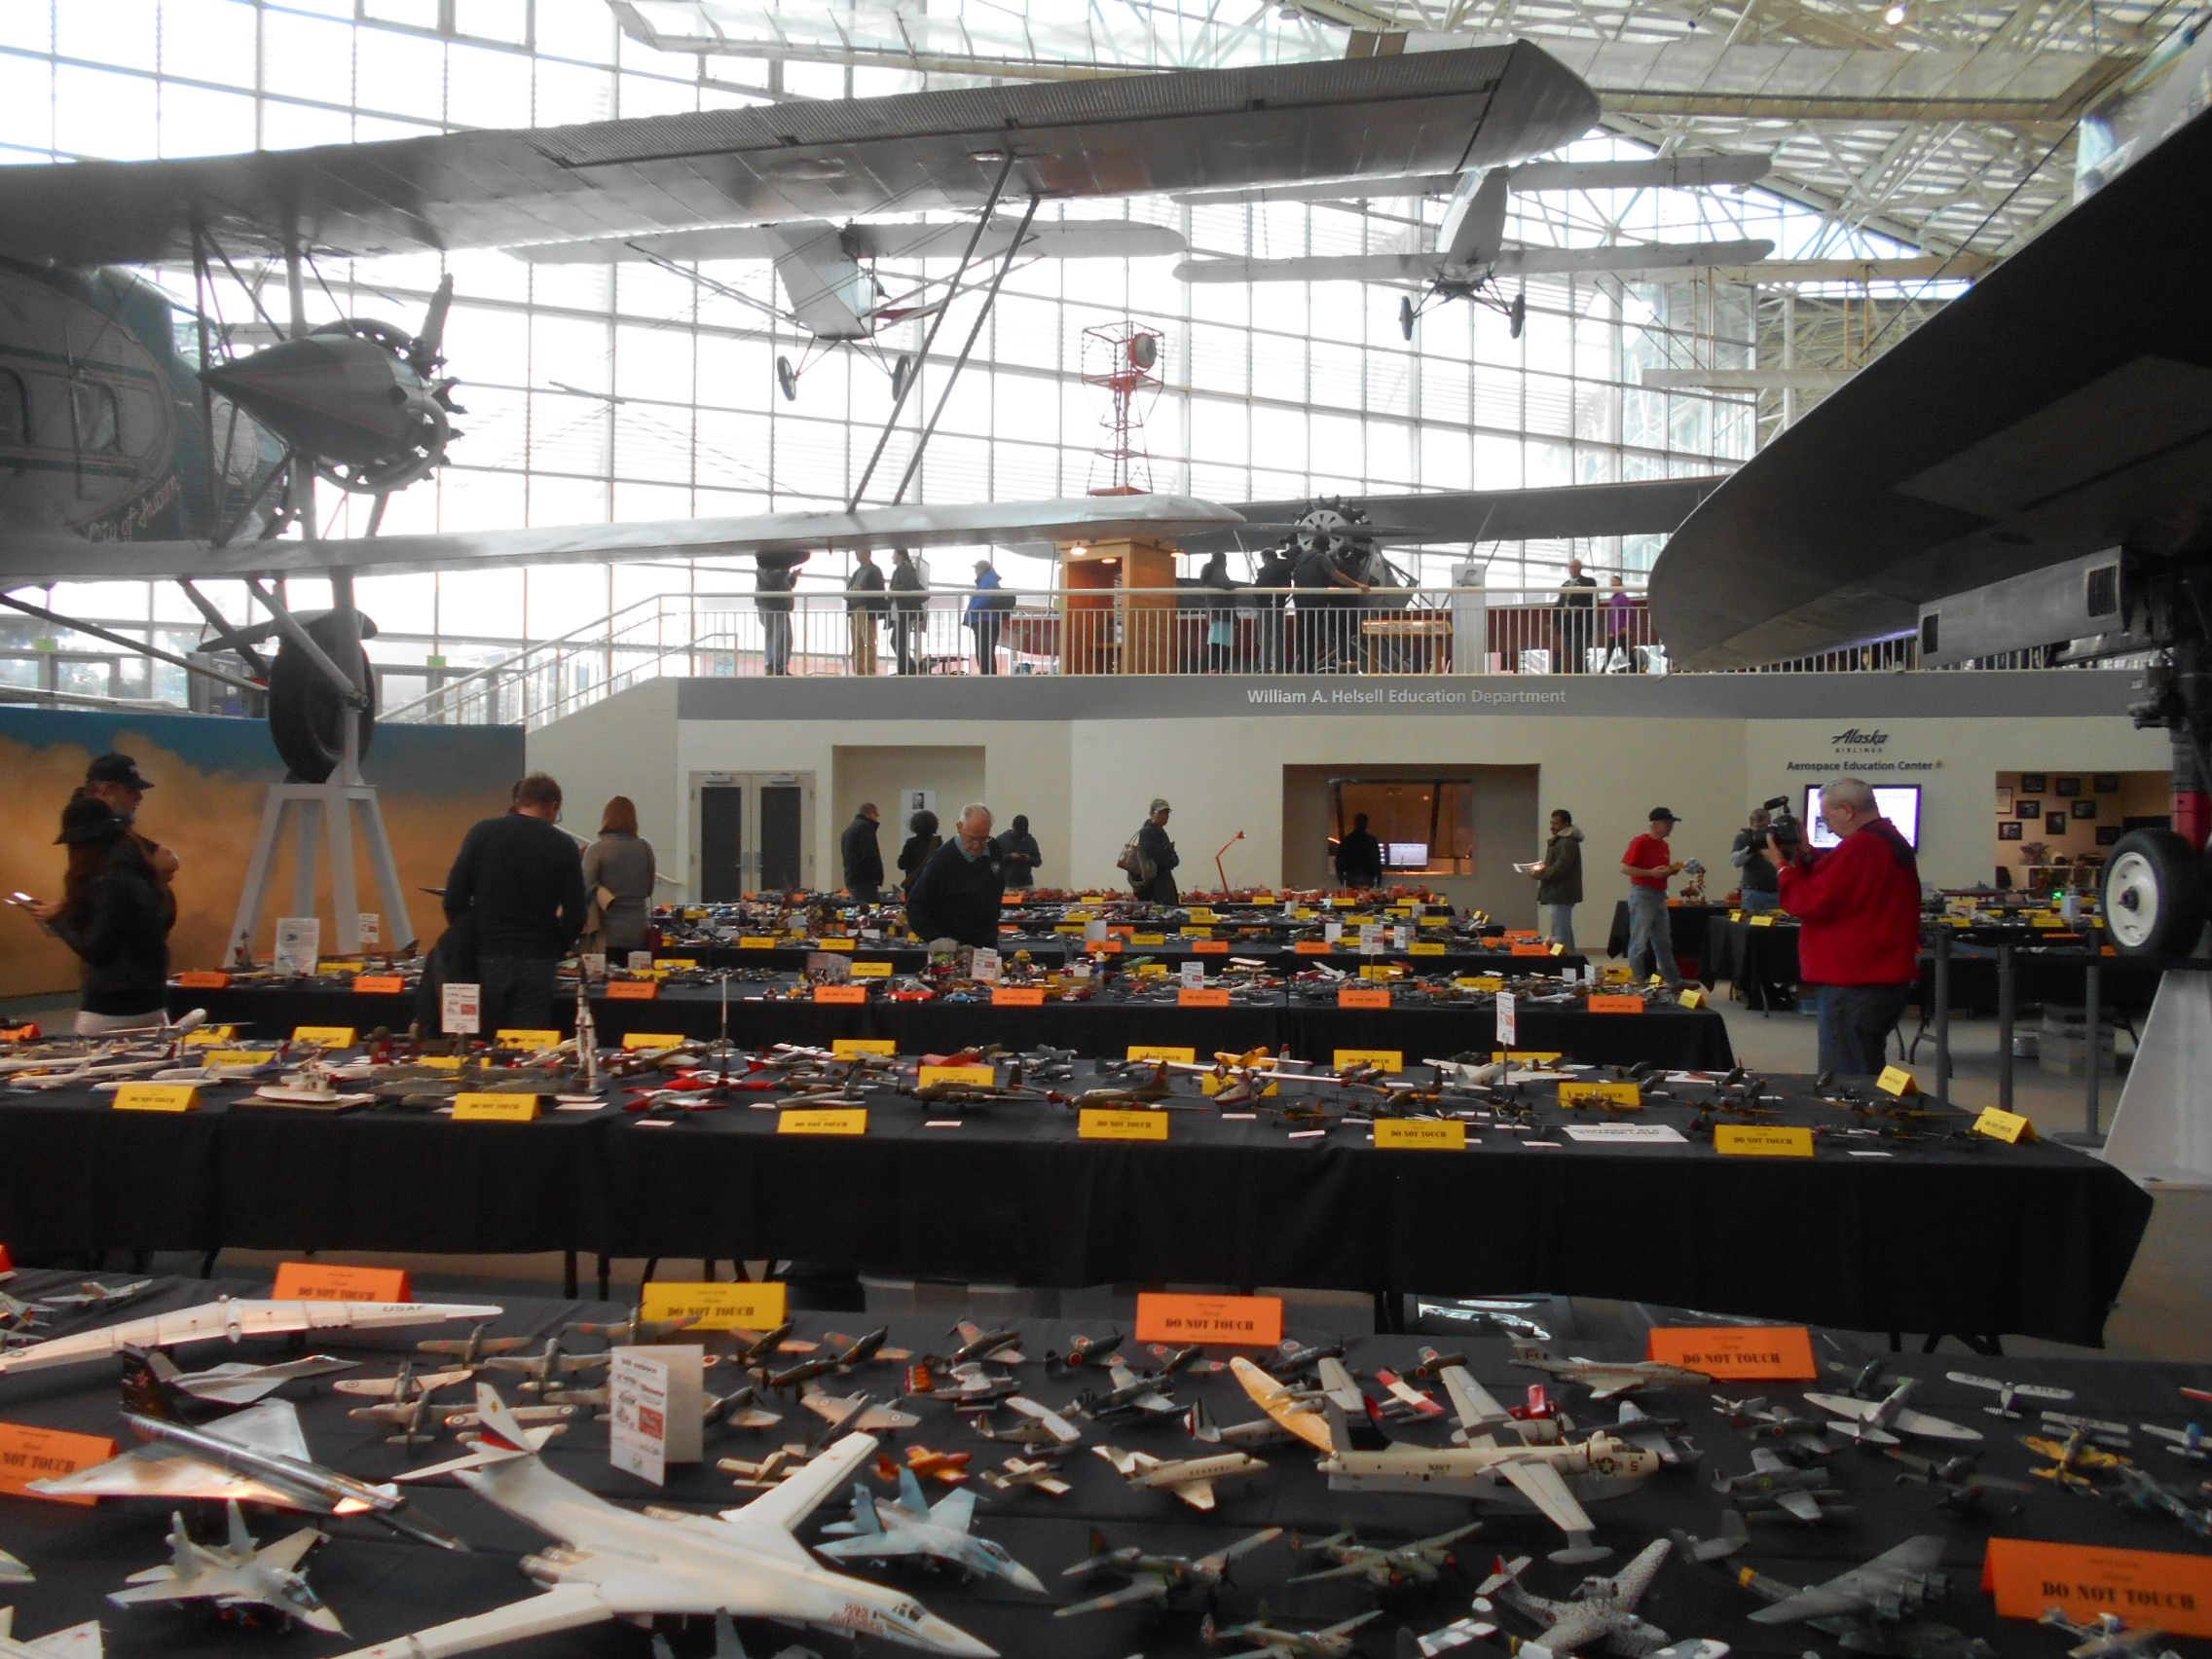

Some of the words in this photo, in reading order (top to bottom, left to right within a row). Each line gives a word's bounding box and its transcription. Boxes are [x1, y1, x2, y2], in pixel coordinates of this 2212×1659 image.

[1247, 689, 1307, 703] William
[1311, 690, 1328, 703] A.
[1332, 689, 1383, 703] Helsell
[1388, 689, 1466, 703] Education
[1471, 689, 1567, 706] Department
[1831, 728, 1889, 746] Alaska
[1787, 761, 1840, 772] Aerospace
[1843, 761, 1895, 770] Education
[1898, 761, 1933, 770] Center
[299, 1287, 313, 1296] DO
[316, 1288, 336, 1298] NOT
[340, 1290, 375, 1301] TOUCH
[667, 1307, 684, 1316] DO
[716, 1307, 756, 1316] TOUCH
[1165, 1318, 1182, 1328] DO
[1186, 1319, 1210, 1329] NOT
[1213, 1320, 1255, 1331] TOUCH
[1682, 1353, 1701, 1364] DO
[1705, 1353, 1731, 1364] NOT
[1736, 1353, 1781, 1364] TOUCH
[3, 1452, 26, 1467] NOT
[32, 1456, 76, 1473] TOUCH
[2042, 1581, 2070, 1597] DO
[2077, 1585, 2118, 1603] NOT
[2126, 1589, 2196, 1610] TOUCH
